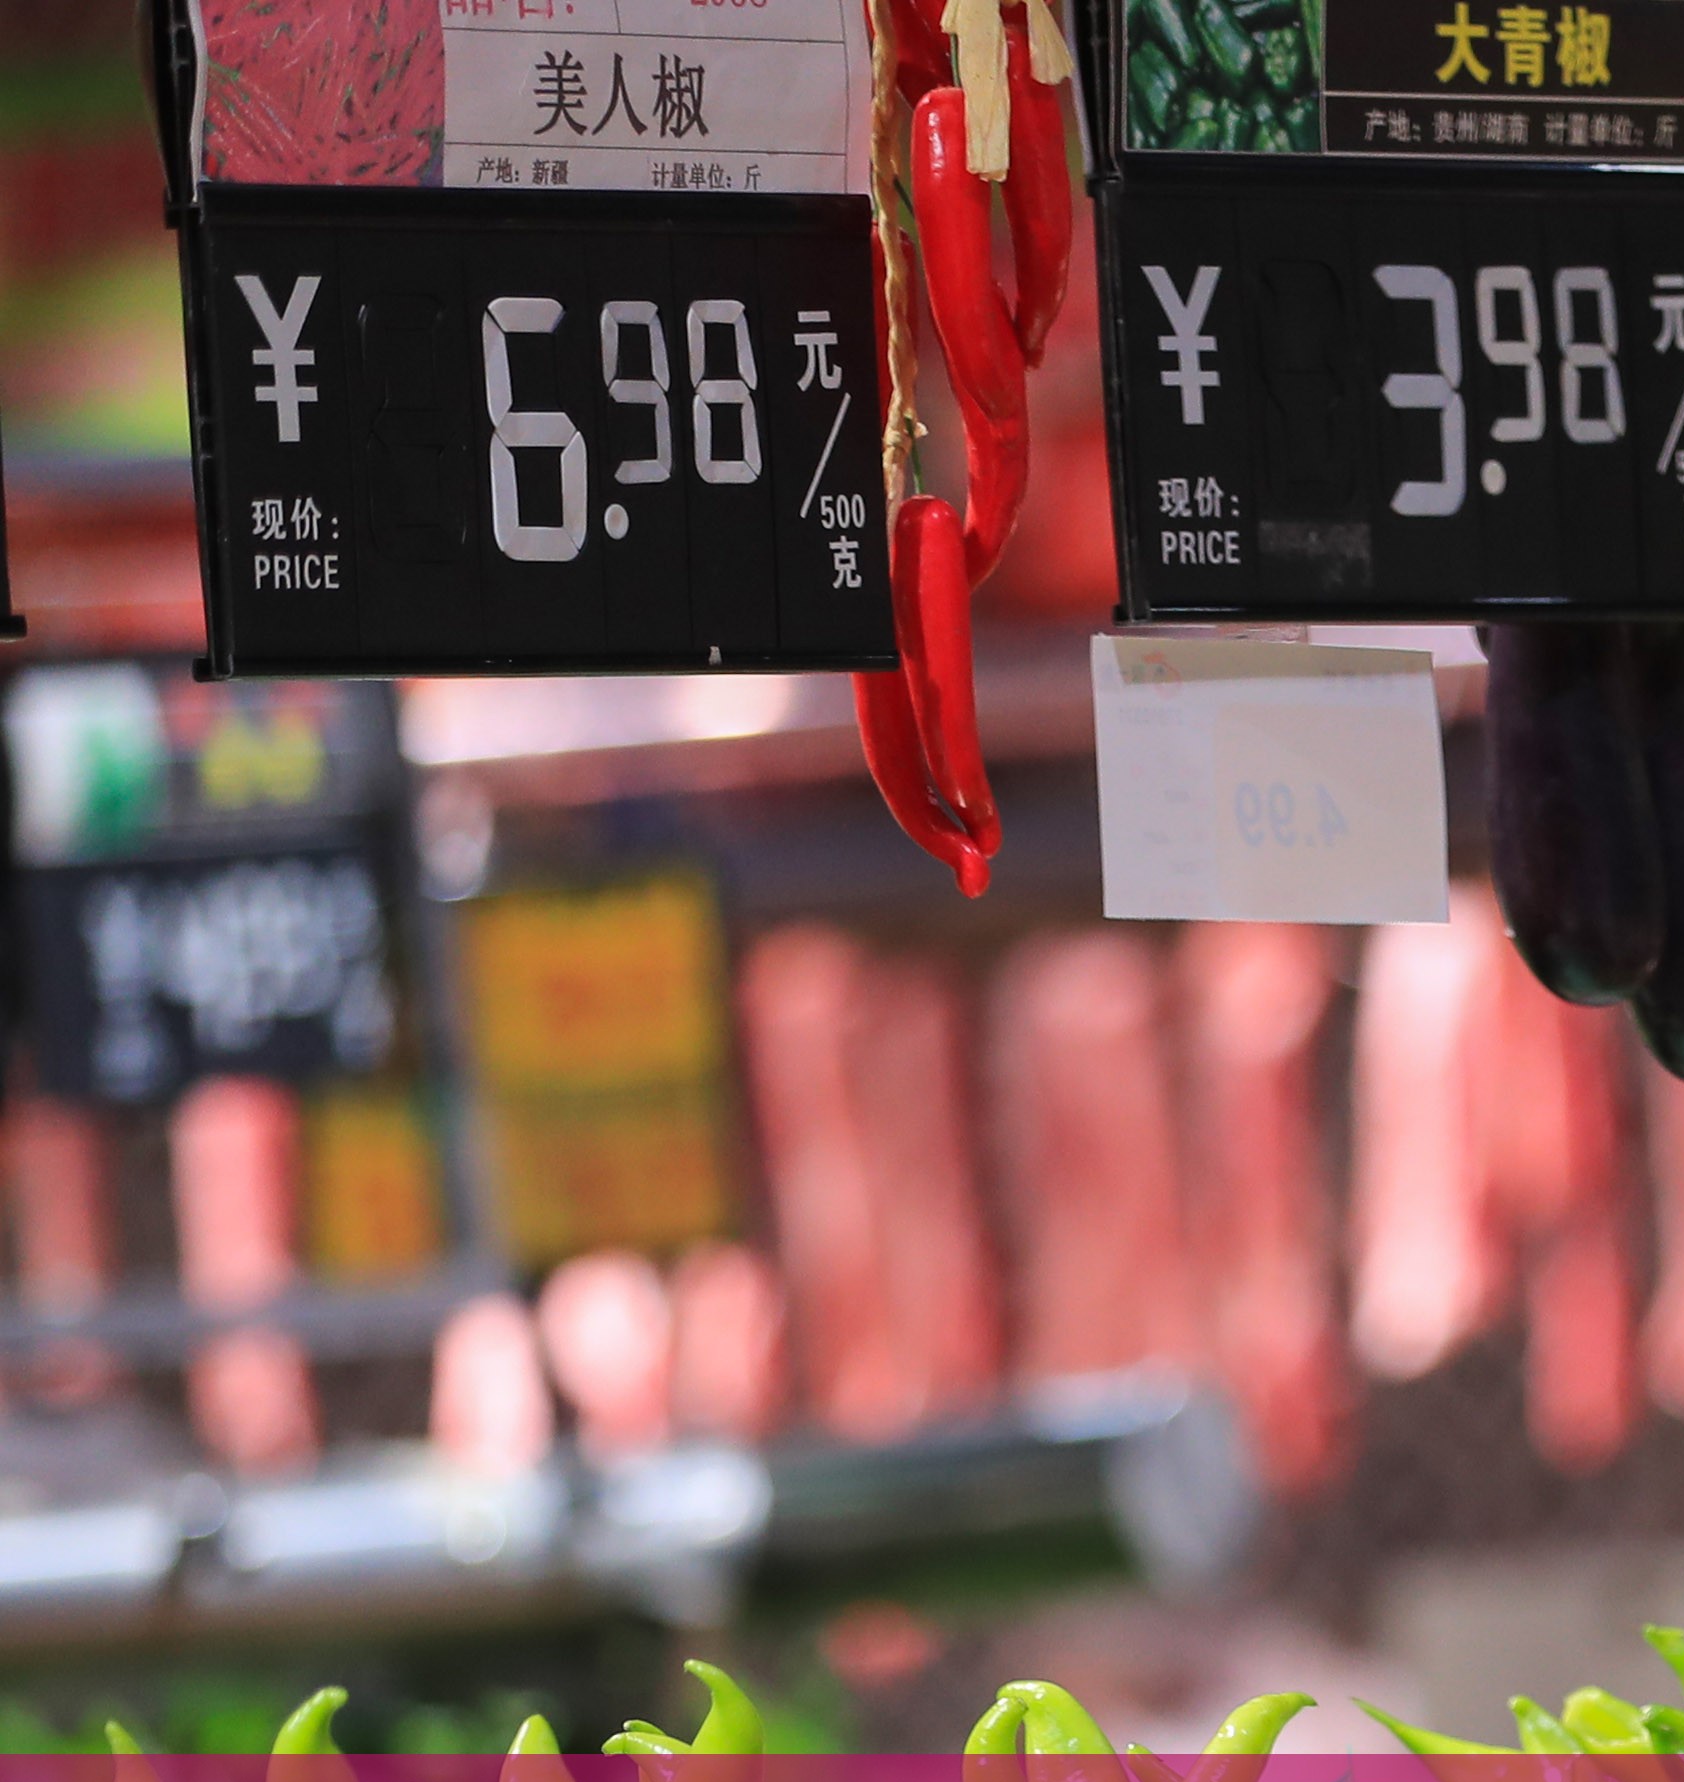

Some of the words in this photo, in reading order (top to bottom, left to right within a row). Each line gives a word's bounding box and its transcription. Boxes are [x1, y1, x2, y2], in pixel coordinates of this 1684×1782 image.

[1434, 3, 1612, 89] 大青椒
[532, 50, 711, 139] 美人椒
[482, 297, 762, 562] 6.98
[1373, 266, 1626, 517] 3.98
[254, 555, 340, 590] PRICE
[1161, 531, 1241, 565] PRICE
